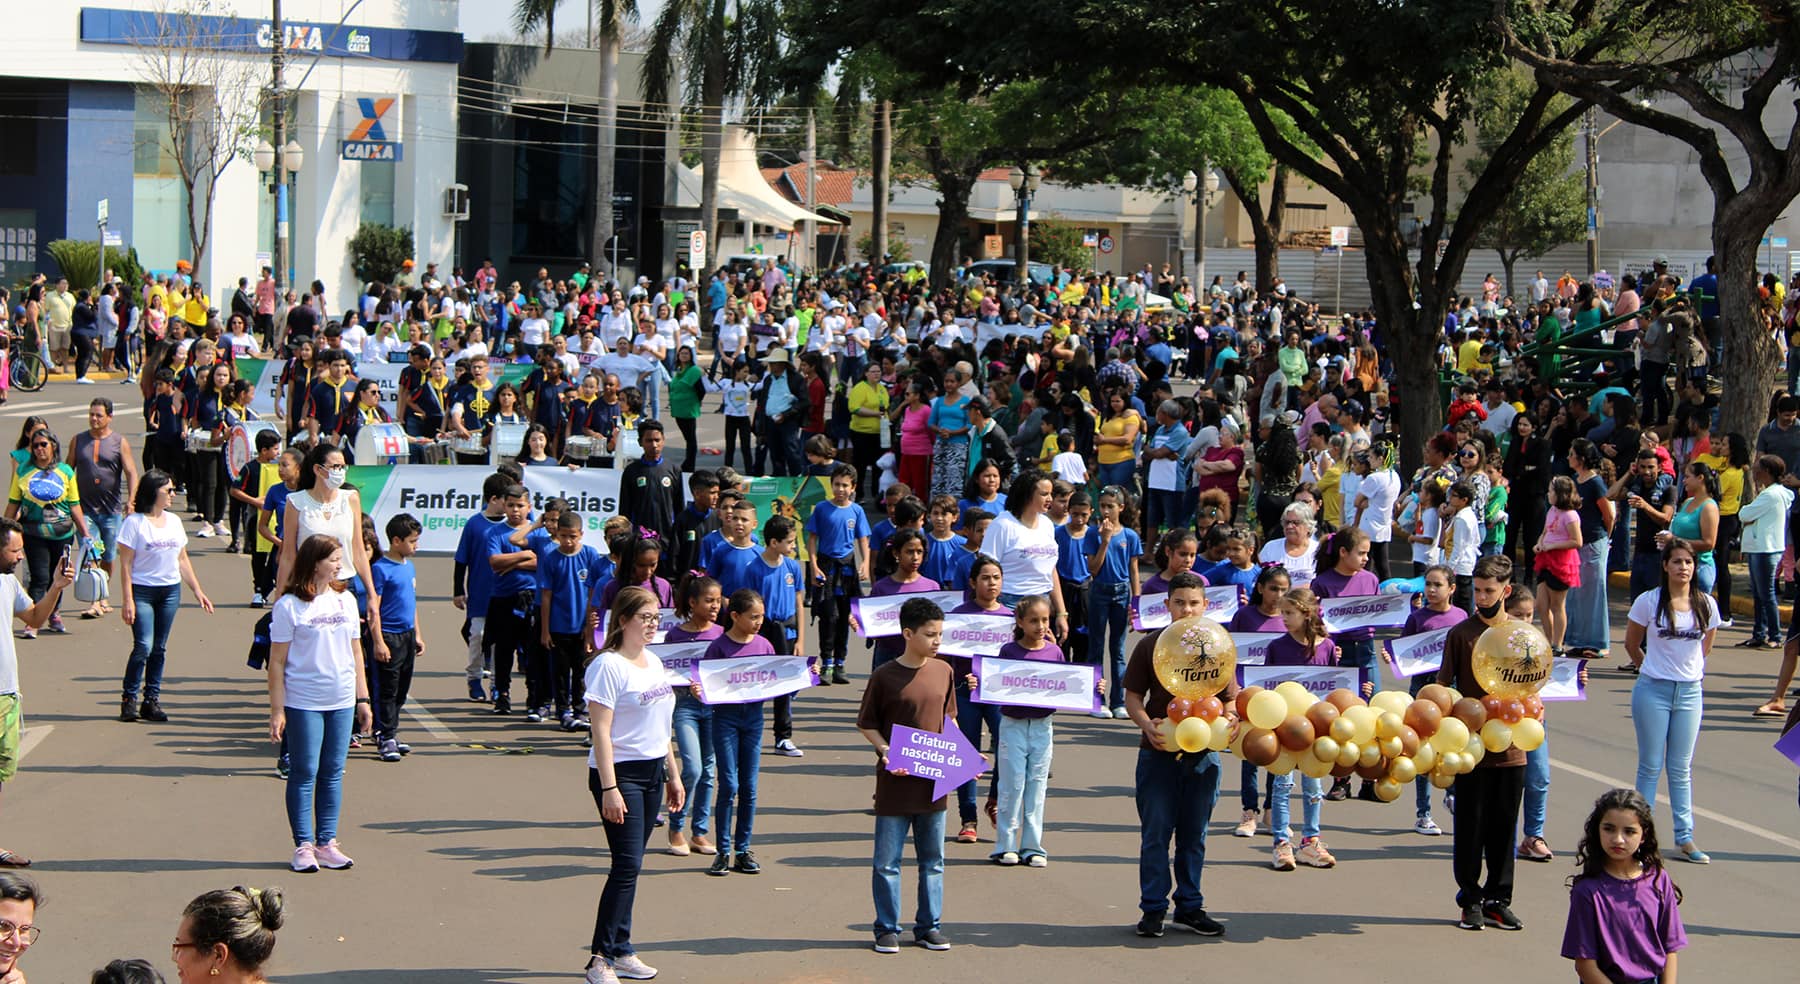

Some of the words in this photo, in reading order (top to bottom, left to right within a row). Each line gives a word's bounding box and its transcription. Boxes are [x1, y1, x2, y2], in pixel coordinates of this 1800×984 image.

[256, 24, 323, 51] CIXA
[344, 143, 394, 159] CAIXA
[1102, 239, 1113, 249] 40
[1328, 602, 1389, 618] SOBRIEDADE
[726, 669, 778, 686] JUSTIÇA
[1002, 674, 1067, 692] INOCÊNCIA
[911, 731, 957, 752] Criatura
[901, 746, 945, 764] nascida
[947, 754, 962, 767] da
[913, 761, 945, 779] Terra.
